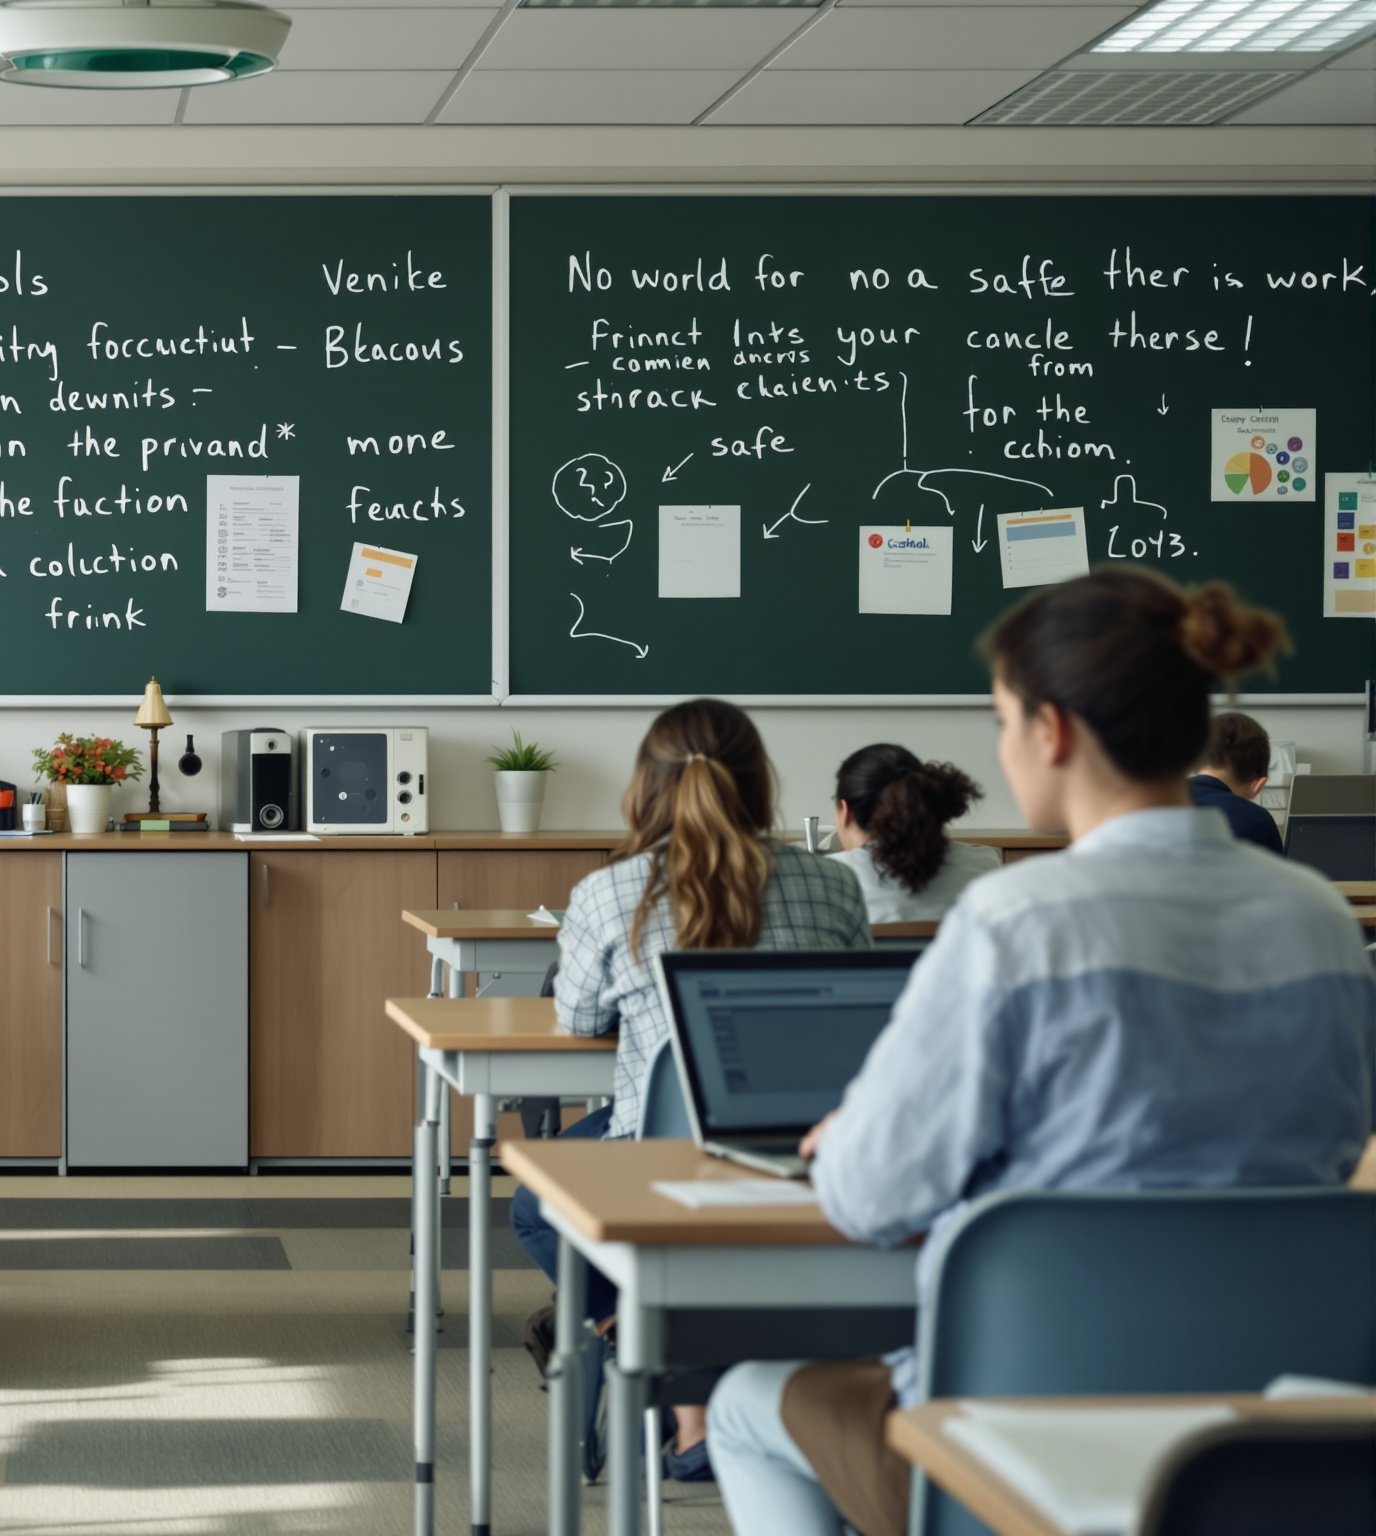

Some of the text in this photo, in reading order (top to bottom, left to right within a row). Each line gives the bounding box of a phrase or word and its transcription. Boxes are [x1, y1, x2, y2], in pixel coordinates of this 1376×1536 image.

[568, 250, 614, 293] No
[630, 256, 732, 292] world
[754, 253, 805, 292] for
[906, 268, 939, 290] a
[1102, 245, 1191, 290] ther
[836, 326, 922, 367] your
[1026, 352, 1095, 378] from
[1035, 392, 1092, 425] the
[65, 424, 122, 458] the
[709, 424, 796, 460] safe
